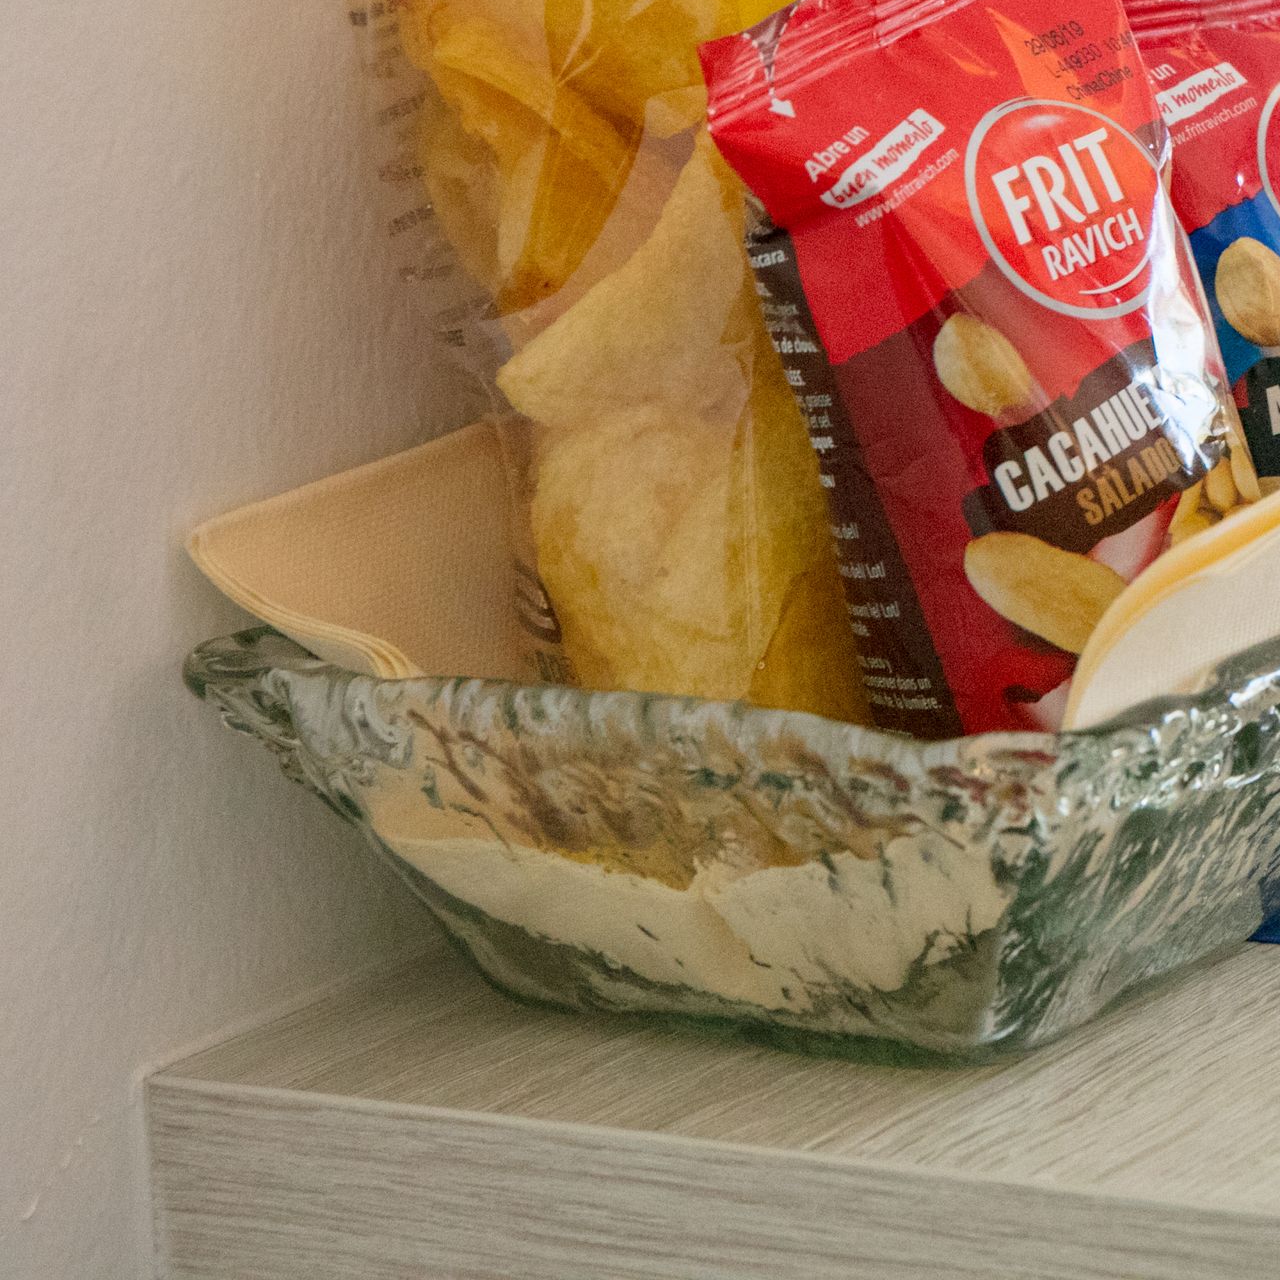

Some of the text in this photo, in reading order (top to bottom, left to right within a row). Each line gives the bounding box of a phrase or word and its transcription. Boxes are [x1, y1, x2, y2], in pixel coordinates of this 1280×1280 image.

[1149, 63, 1178, 82] un
[1170, 65, 1238, 108] momento
[803, 124, 872, 185] Abre un
[829, 117, 935, 204] buen momento
[853, 147, 960, 229] www.fritravich.com
[990, 126, 1125, 246] FRIT
[1040, 207, 1145, 282] RAVICH
[1075, 436, 1183, 526] SALADO
